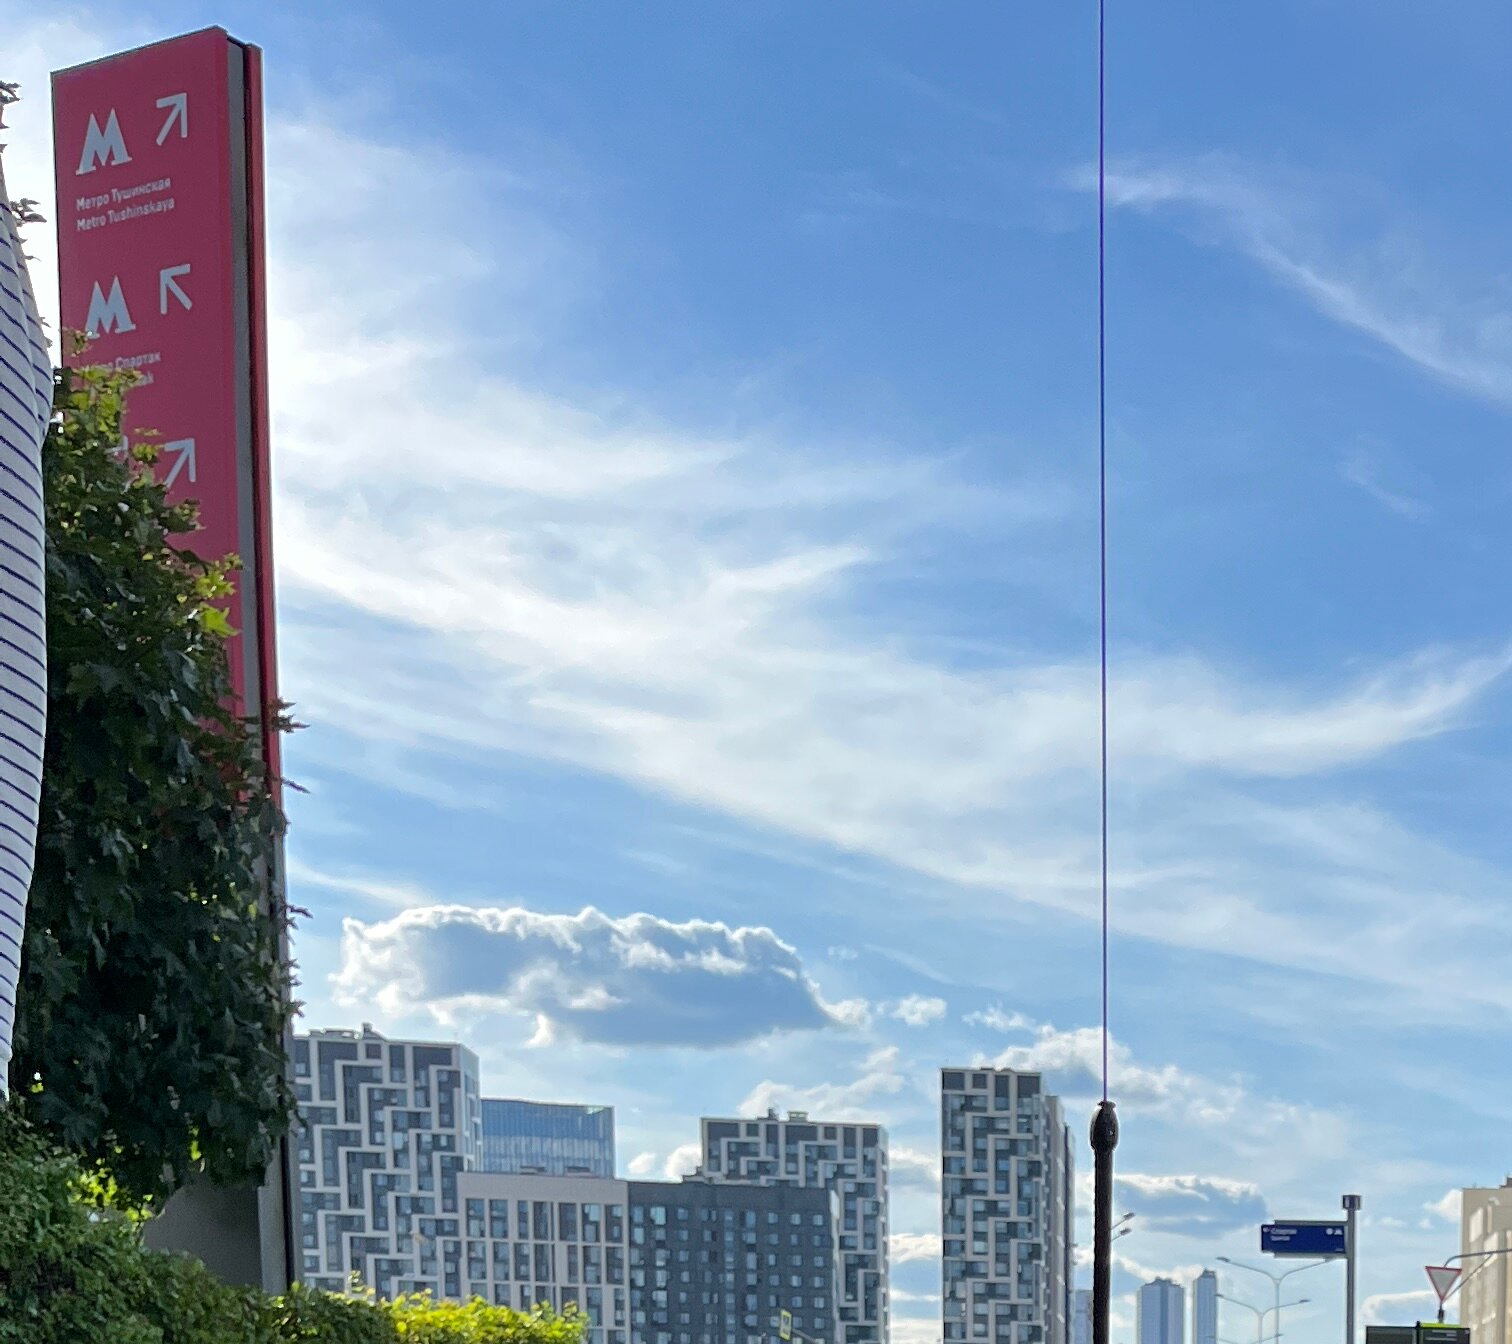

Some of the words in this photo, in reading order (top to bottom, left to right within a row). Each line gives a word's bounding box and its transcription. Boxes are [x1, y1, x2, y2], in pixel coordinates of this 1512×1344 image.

[76, 193, 110, 212] Метро
[111, 178, 171, 203] Тушинская
[76, 214, 107, 232] Metro
[107, 198, 175, 223] Tushinskaya
